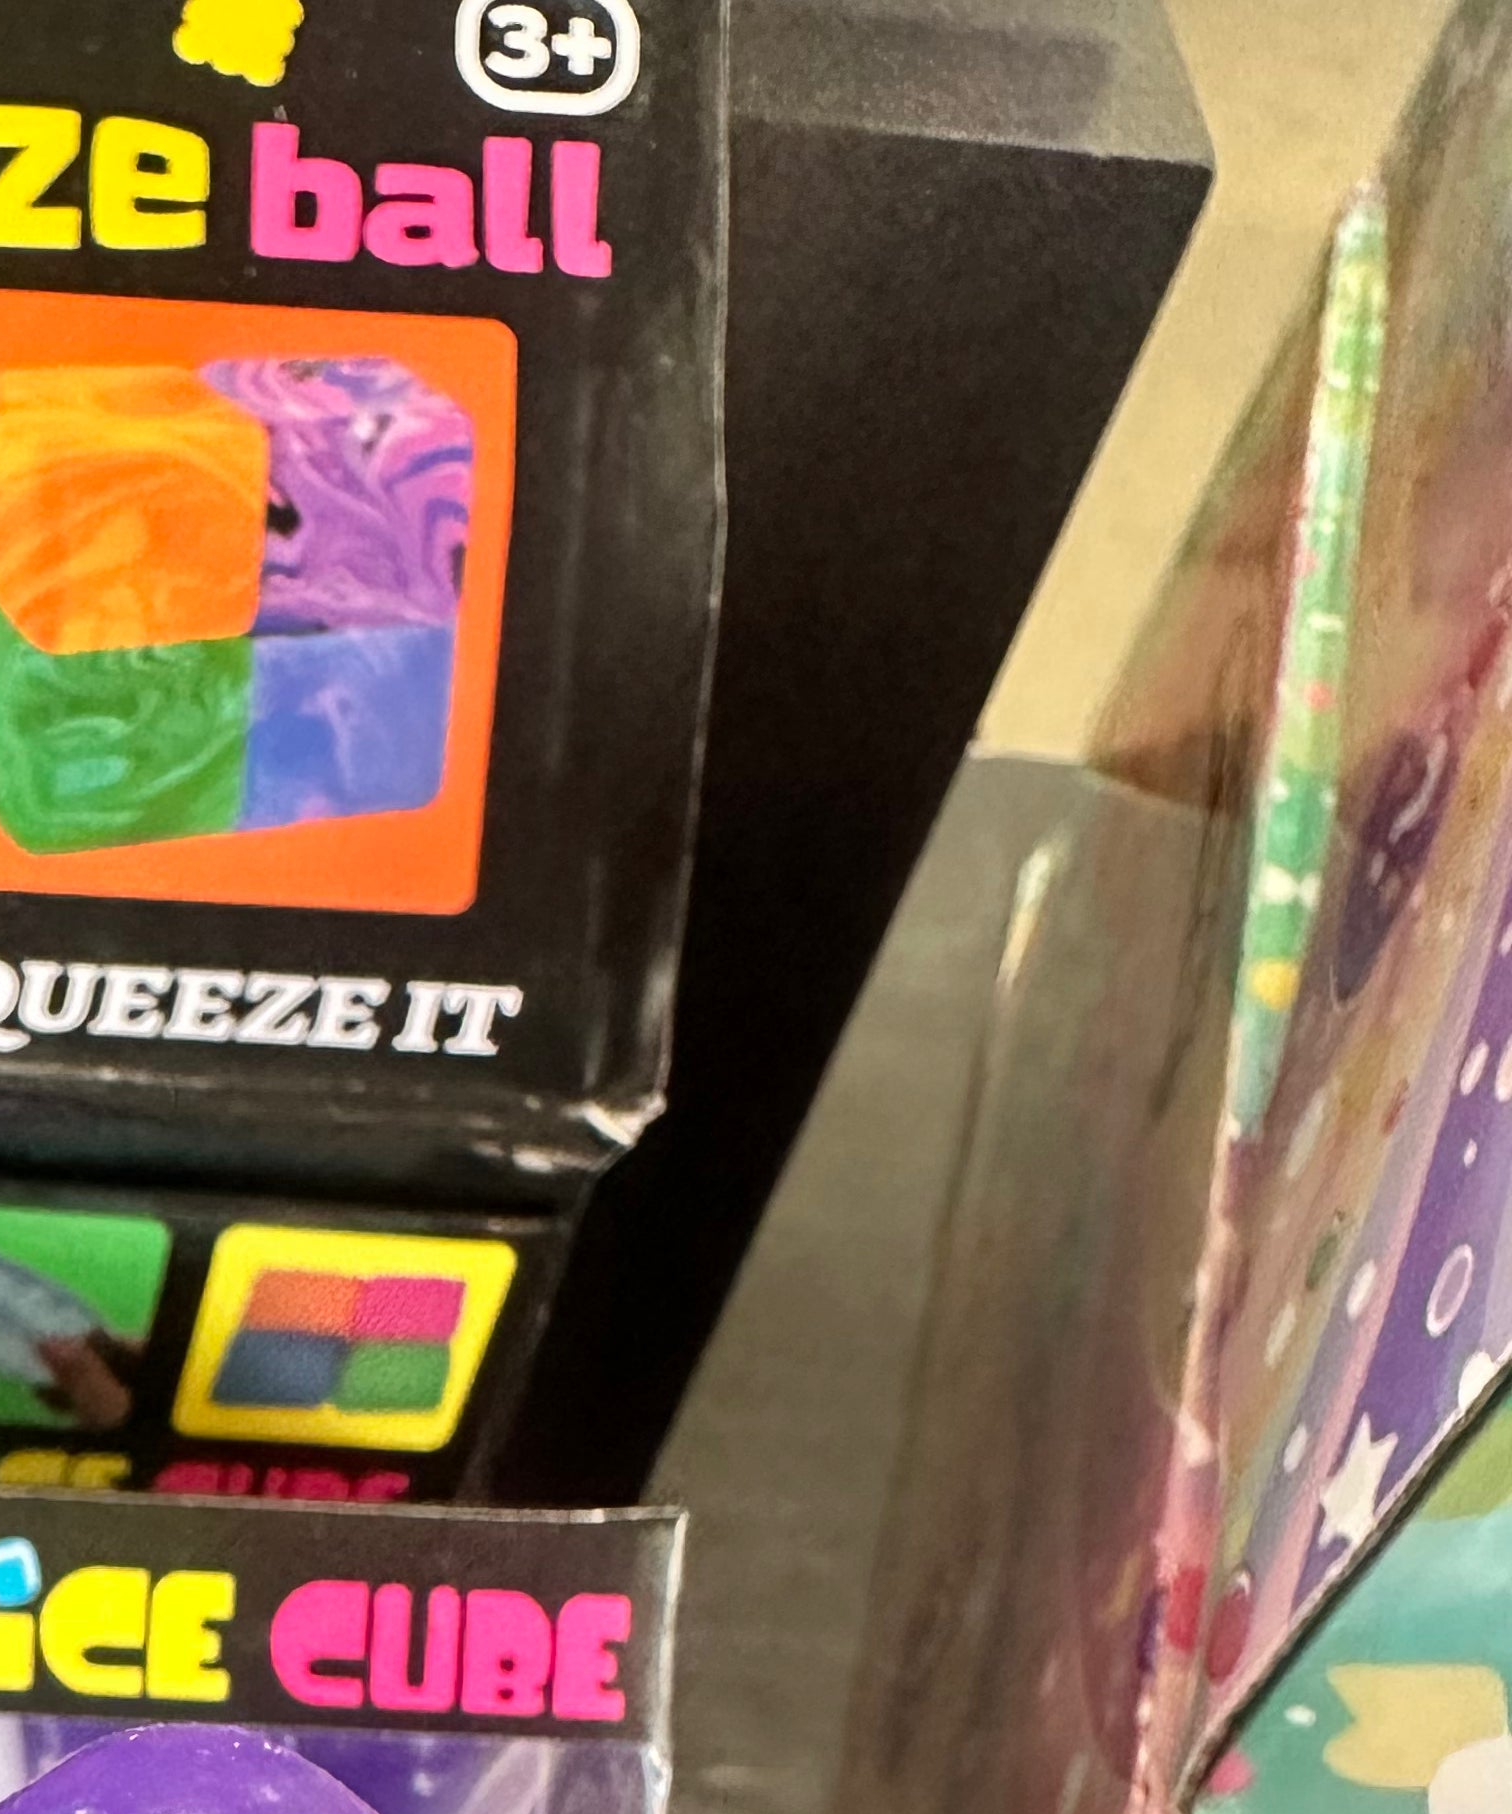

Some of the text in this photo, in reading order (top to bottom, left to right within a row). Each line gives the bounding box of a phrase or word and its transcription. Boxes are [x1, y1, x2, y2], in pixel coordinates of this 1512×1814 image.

[484, 3, 614, 79] 3+
[249, 119, 614, 280] ball
[391, 980, 524, 1057] IT
[269, 1578, 634, 1723] CUBE
